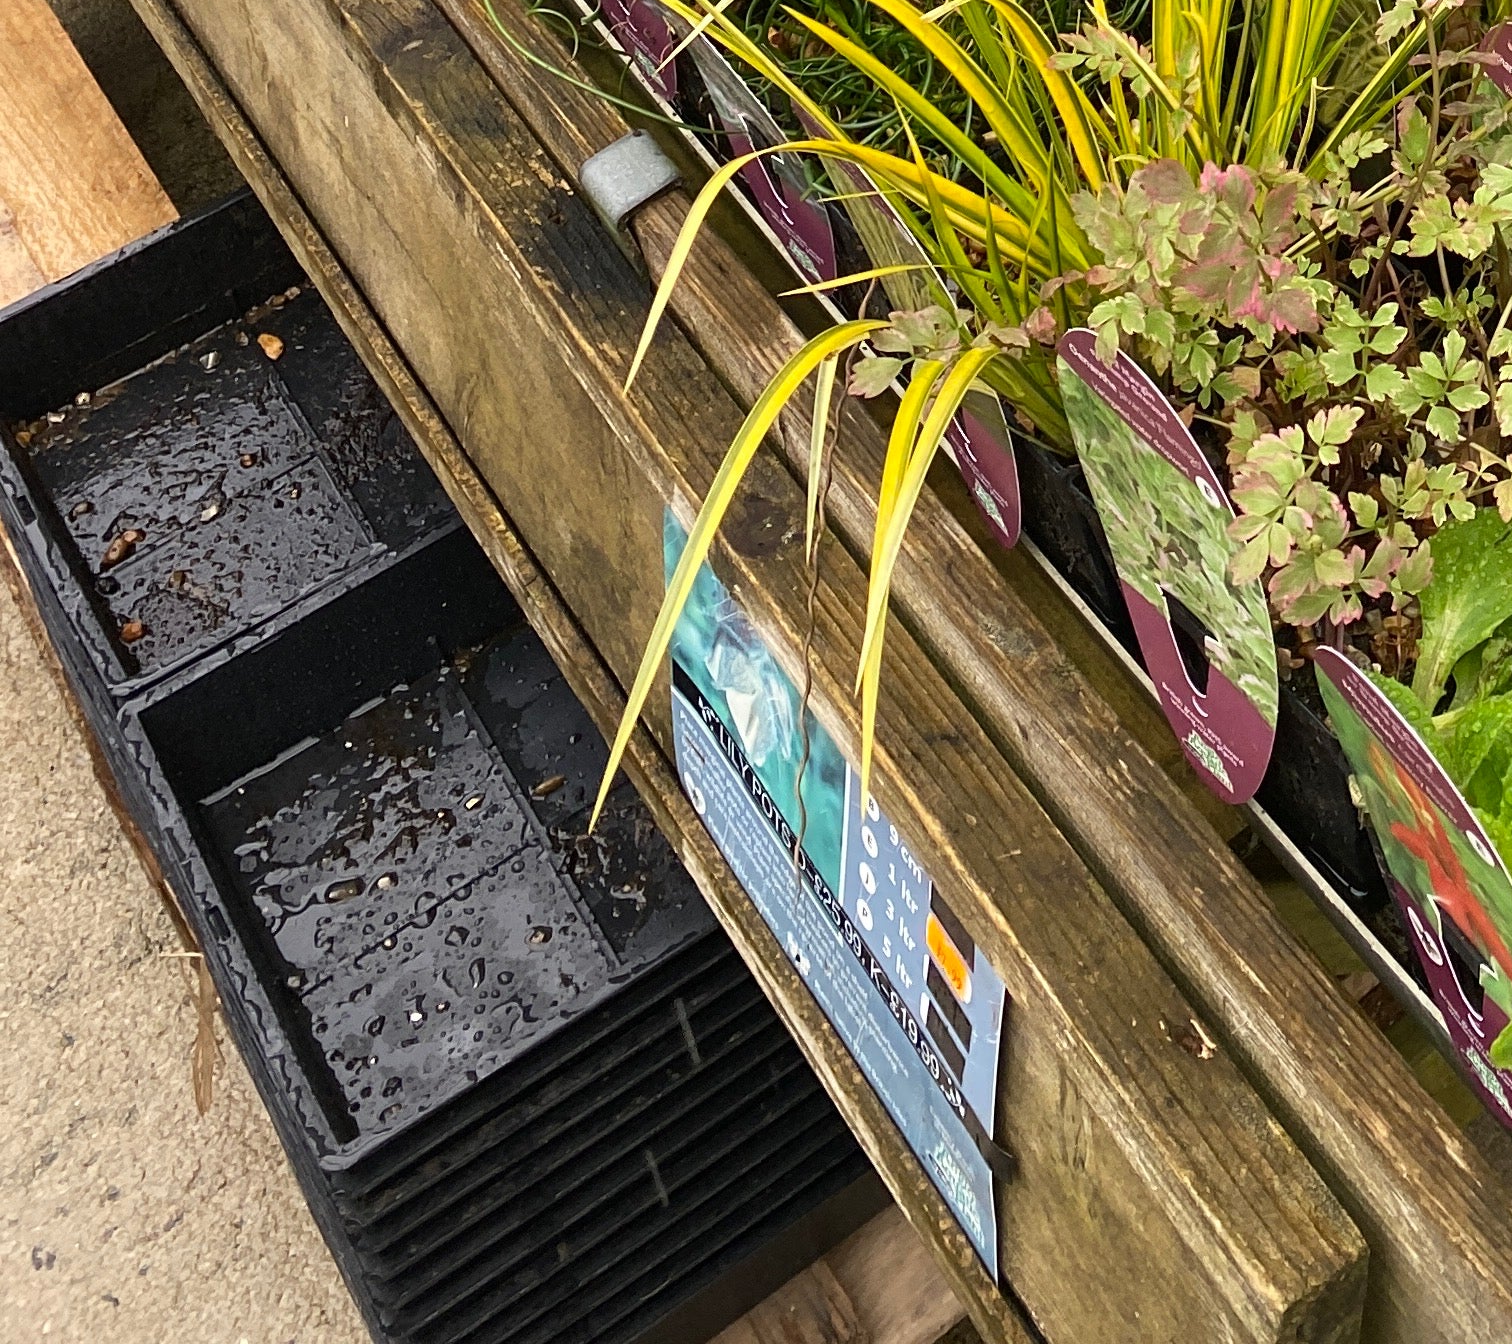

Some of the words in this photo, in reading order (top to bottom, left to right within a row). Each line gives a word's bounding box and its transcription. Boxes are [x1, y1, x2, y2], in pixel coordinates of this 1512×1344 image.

[719, 728, 749, 779] LILY
[753, 780, 791, 849] POTS
[890, 825, 899, 846] 9
[901, 846, 922, 884] cm
[888, 863, 896, 885] 1
[902, 880, 918, 914] ltr
[886, 899, 894, 921] 3
[900, 917, 915, 951] ltr
[883, 934, 891, 958] 5
[896, 954, 912, 989] ltr
